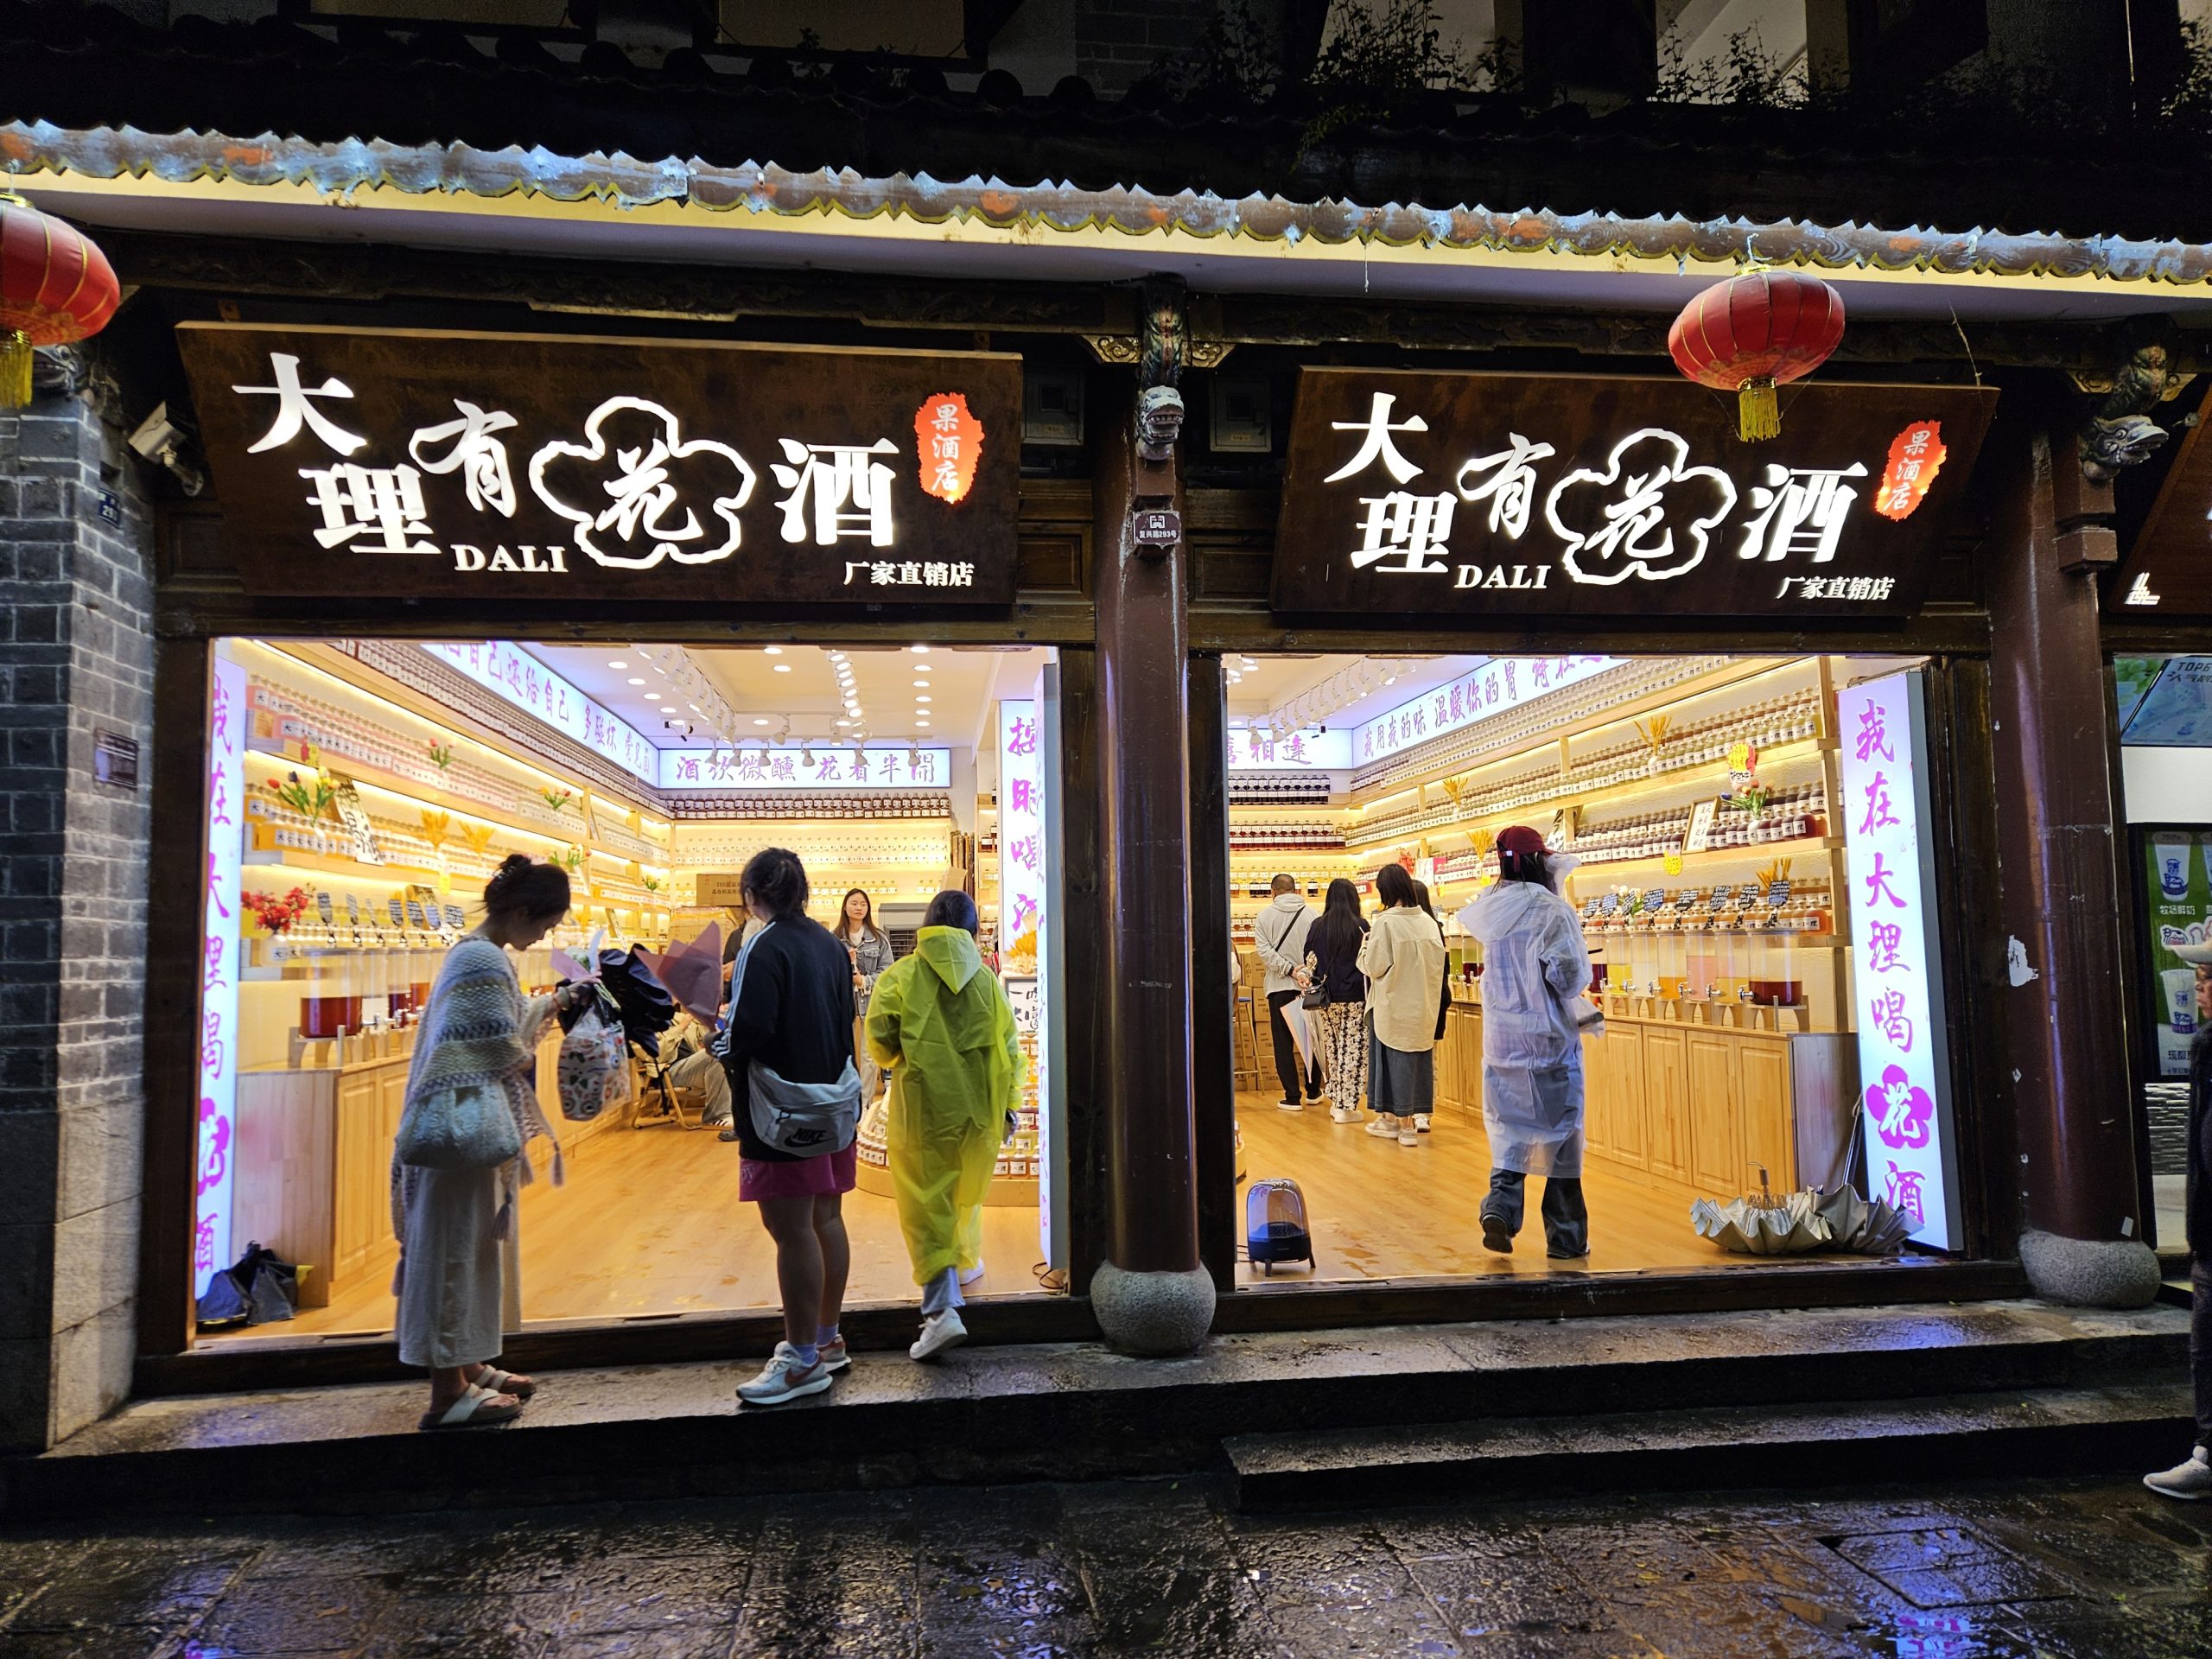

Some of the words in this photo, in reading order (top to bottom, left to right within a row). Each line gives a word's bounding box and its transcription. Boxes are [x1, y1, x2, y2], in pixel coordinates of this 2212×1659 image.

[931, 403, 960, 493] 果酒店
[1883, 430, 1929, 512] 果酒店
[450, 543, 569, 572] DALI
[843, 561, 975, 587] 厂家直销店
[1453, 564, 1551, 589] DALI
[1777, 576, 1896, 601] 厂家直销店
[1434, 660, 1518, 728] 温暖你的胃
[1855, 697, 1927, 1226] 我在大理喝花酒
[792, 1127, 827, 1142] NIKE
